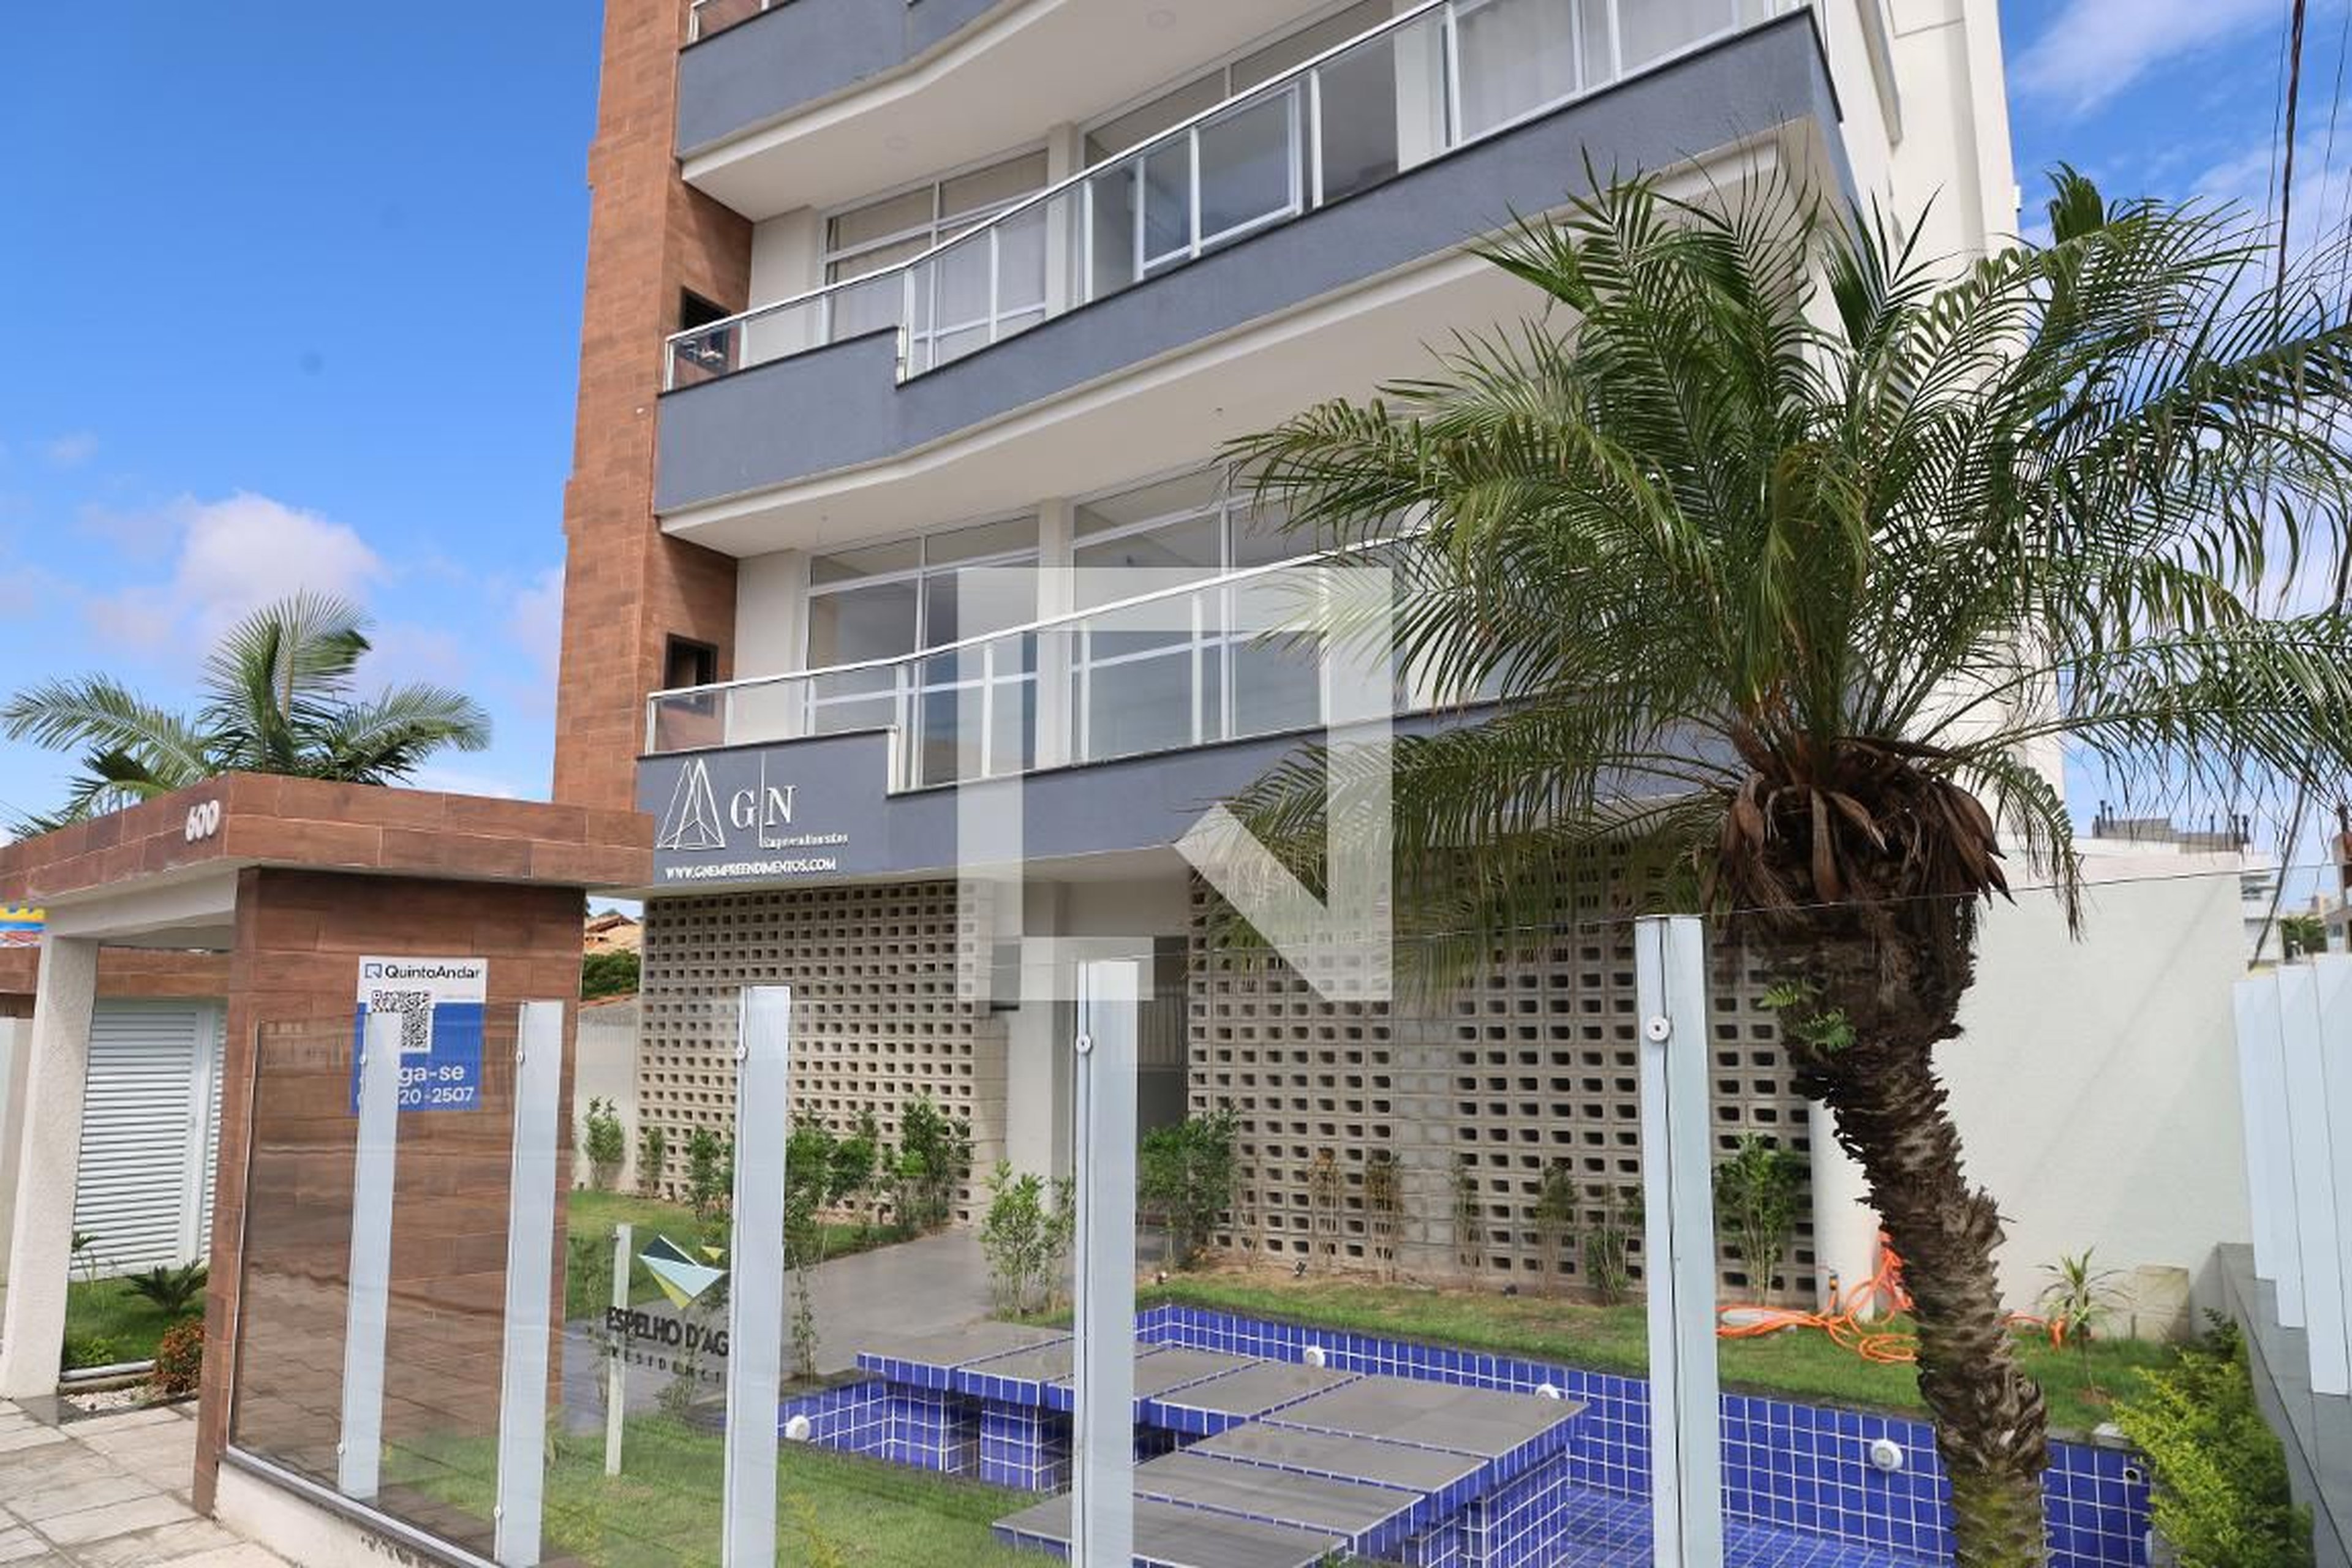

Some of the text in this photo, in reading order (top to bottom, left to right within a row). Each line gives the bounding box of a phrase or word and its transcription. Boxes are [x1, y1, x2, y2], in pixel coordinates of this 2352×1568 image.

[186, 800, 220, 842] 600
[385, 965, 480, 979] QuintoAndar
[399, 1066, 464, 1087] ga-se
[399, 1088, 474, 1104] 20-2507
[606, 1306, 729, 1357] ESPELHO D'AG
[612, 1346, 720, 1383] RESIDENCI
